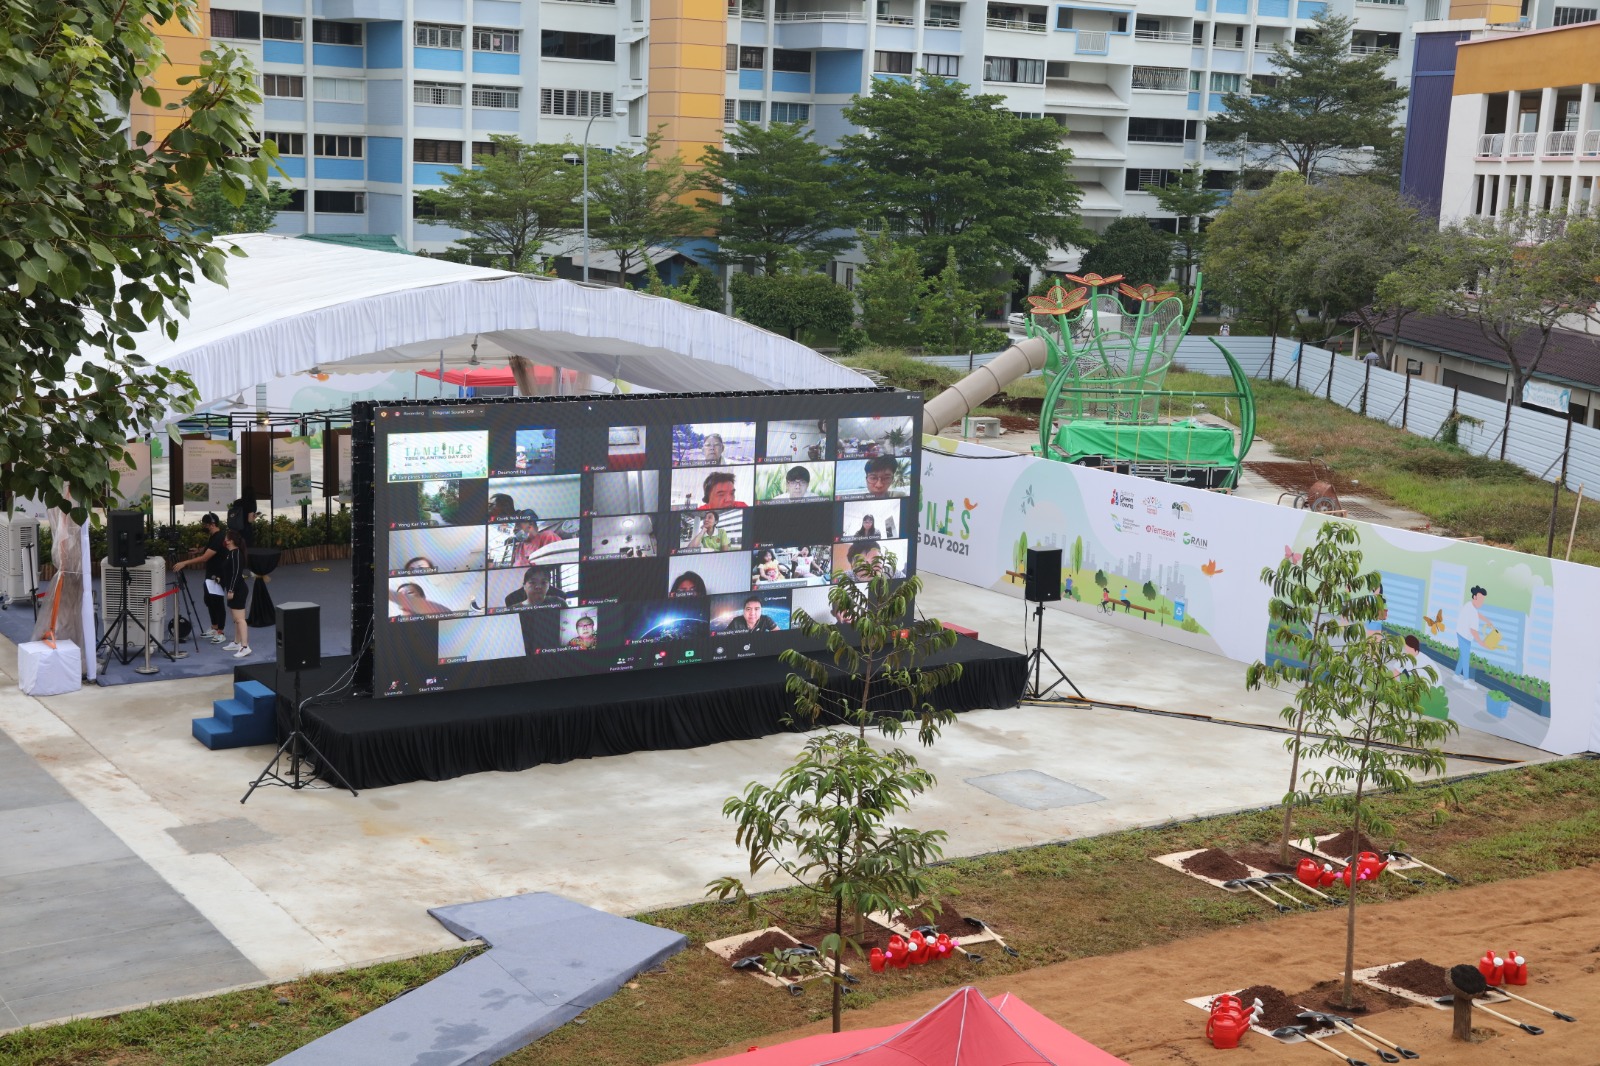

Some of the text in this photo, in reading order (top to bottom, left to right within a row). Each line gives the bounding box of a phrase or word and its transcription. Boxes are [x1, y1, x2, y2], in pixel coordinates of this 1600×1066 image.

[405, 442, 473, 456] TAMPINES
[1151, 525, 1177, 538] Temasek
[923, 533, 945, 549] DAY
[946, 540, 969, 556] 2021
